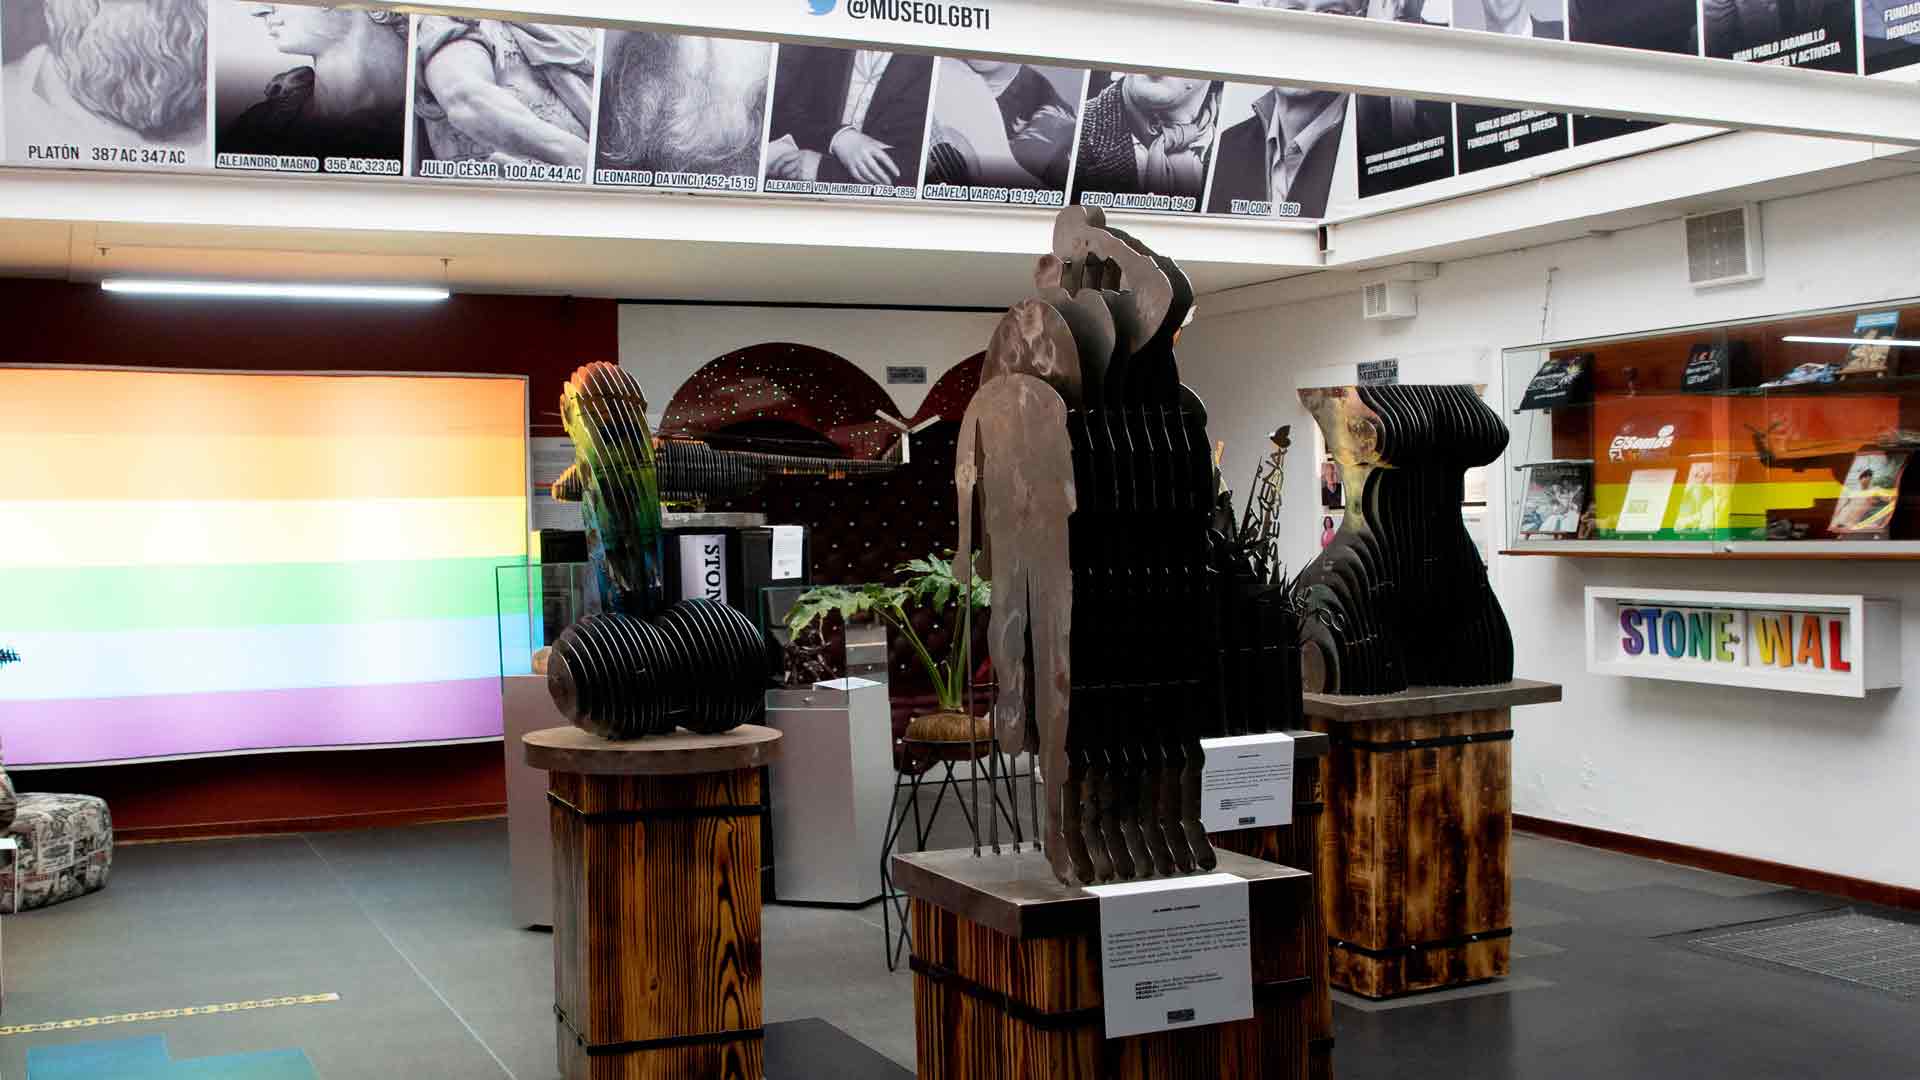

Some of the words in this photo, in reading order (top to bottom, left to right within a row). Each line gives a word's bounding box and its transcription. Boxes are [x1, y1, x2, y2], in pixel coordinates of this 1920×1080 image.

[847, 0, 990, 30] @MUSEOLGBTI
[1780, 28, 1825, 51] JARAMILLO
[1798, 41, 1840, 63] ACTIVISTA
[28, 143, 79, 160] PLATÓN
[92, 147, 118, 161] 387
[120, 148, 137, 162] AC
[141, 150, 166, 163] 347
[169, 150, 185, 164] AC
[218, 155, 278, 169] ALEJANDRO
[280, 157, 317, 170] MAGNO
[326, 158, 346, 170] 356
[349, 159, 362, 171] AC
[364, 160, 385, 172] 323
[386, 161, 399, 173] AC
[422, 161, 454, 175] JULIO
[459, 159, 496, 176] CÉSAR
[505, 165, 528, 178] 100
[530, 165, 544, 179] AC
[547, 166, 563, 179] 44
[566, 167, 582, 180] AC
[597, 170, 650, 184] LEONARDO
[656, 172, 669, 184] DA
[671, 173, 697, 186] VINCI
[699, 174, 755, 189] 1452-1519
[766, 181, 811, 191] ALEXANDER
[813, 182, 829, 192] VON
[831, 183, 872, 194] HUMBOLDT
[925, 183, 967, 198] CHÁVELA
[970, 186, 1007, 200] VARGAS
[1009, 189, 1062, 203] 1919-2012
[1081, 192, 1112, 205] PEDRO
[1114, 192, 1168, 209] ALMODÓVAR
[1171, 197, 1195, 210] 1949
[1232, 200, 1247, 213] TIM
[1250, 201, 1272, 215] COOK
[1279, 202, 1299, 215] 1960
[1620, 608, 1735, 663] STONE
[1753, 613, 1851, 673] WAL
